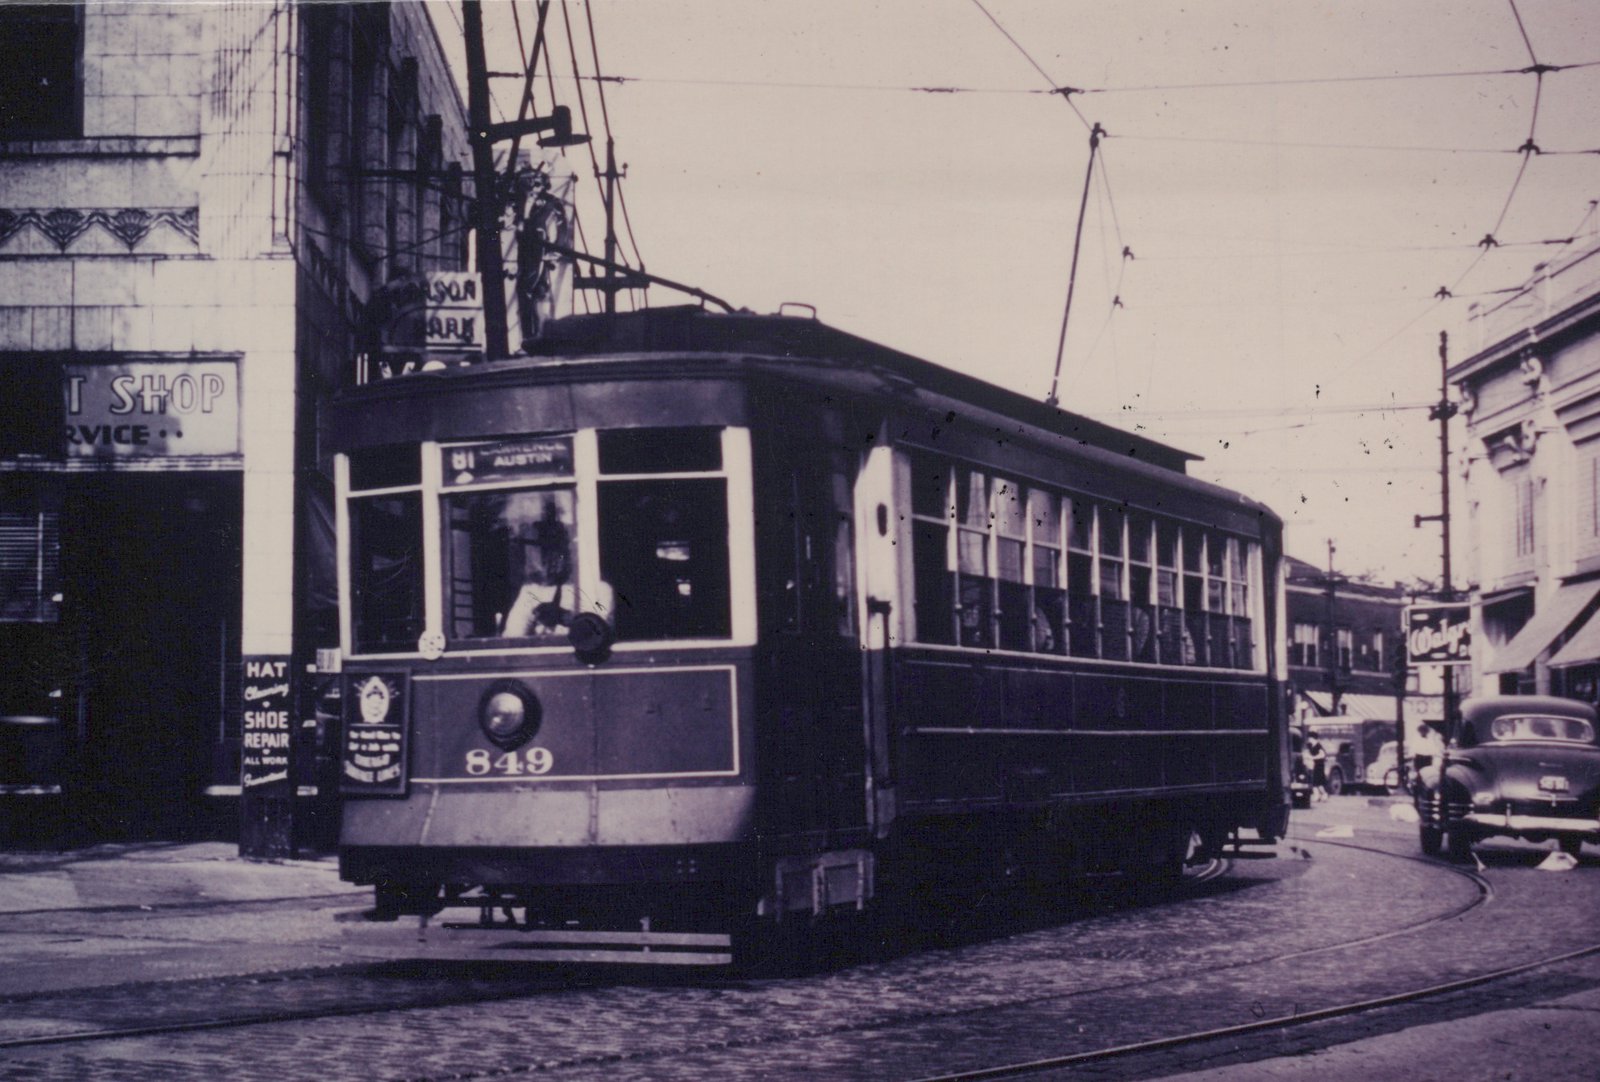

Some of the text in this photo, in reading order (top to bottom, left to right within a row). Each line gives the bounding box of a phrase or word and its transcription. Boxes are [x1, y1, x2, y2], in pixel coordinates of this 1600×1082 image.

[109, 373, 224, 415] SHOP
[452, 449, 475, 470] 81
[493, 452, 553, 467] AUSTIN
[246, 662, 287, 678] HAT
[244, 711, 289, 729] SHOE
[244, 732, 290, 748] REPAIR
[244, 757, 288, 765] ALL WORK
[465, 746, 554, 776] 849
